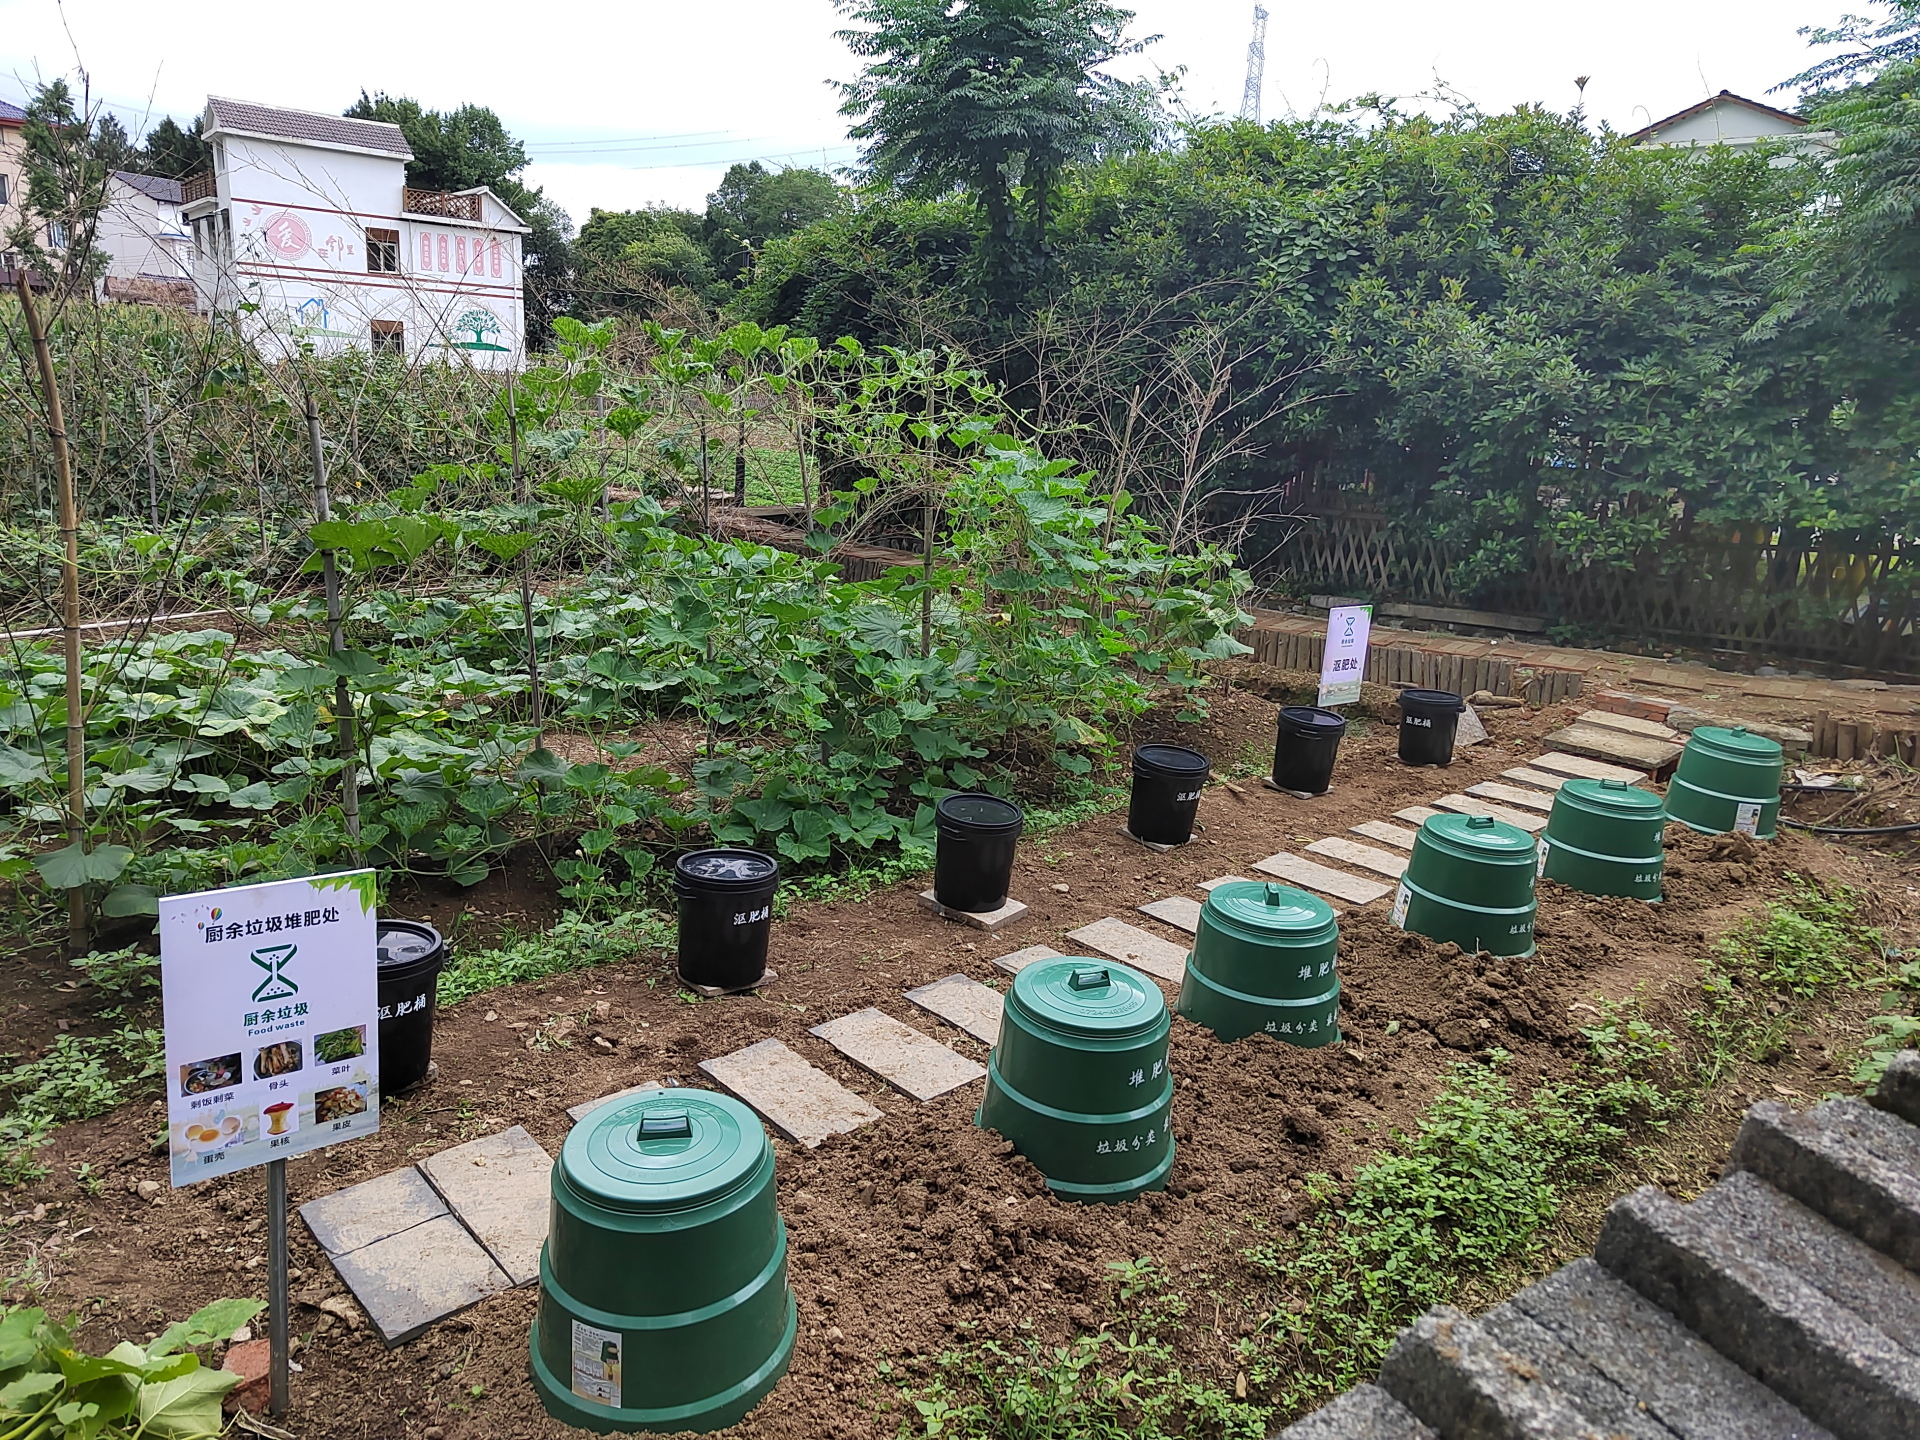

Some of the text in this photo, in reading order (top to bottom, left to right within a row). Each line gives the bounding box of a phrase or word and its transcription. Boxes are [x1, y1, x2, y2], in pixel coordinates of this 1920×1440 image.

[277, 220, 303, 250] 爱
[1332, 657, 1358, 672] 沤肥处
[1405, 715, 1432, 729] 沤肥桶
[732, 905, 769, 926] 沤肥桶
[204, 906, 341, 944] 厨余垃圾堆肥处
[243, 1002, 310, 1028] 厨余垃圾
[248, 1019, 305, 1037] Food waste
[1264, 1018, 1319, 1035] 垃圾分类
[331, 1064, 351, 1076] 菜叶
[1128, 1048, 1170, 1089] 堆肥
[268, 1079, 289, 1091] 骨头
[190, 1092, 235, 1110] 剩饭剩菜
[332, 1120, 352, 1132] 果皮
[270, 1136, 290, 1149] 果核
[1096, 1128, 1157, 1155] 垃圾分类
[203, 1152, 226, 1165] 蛋壳
